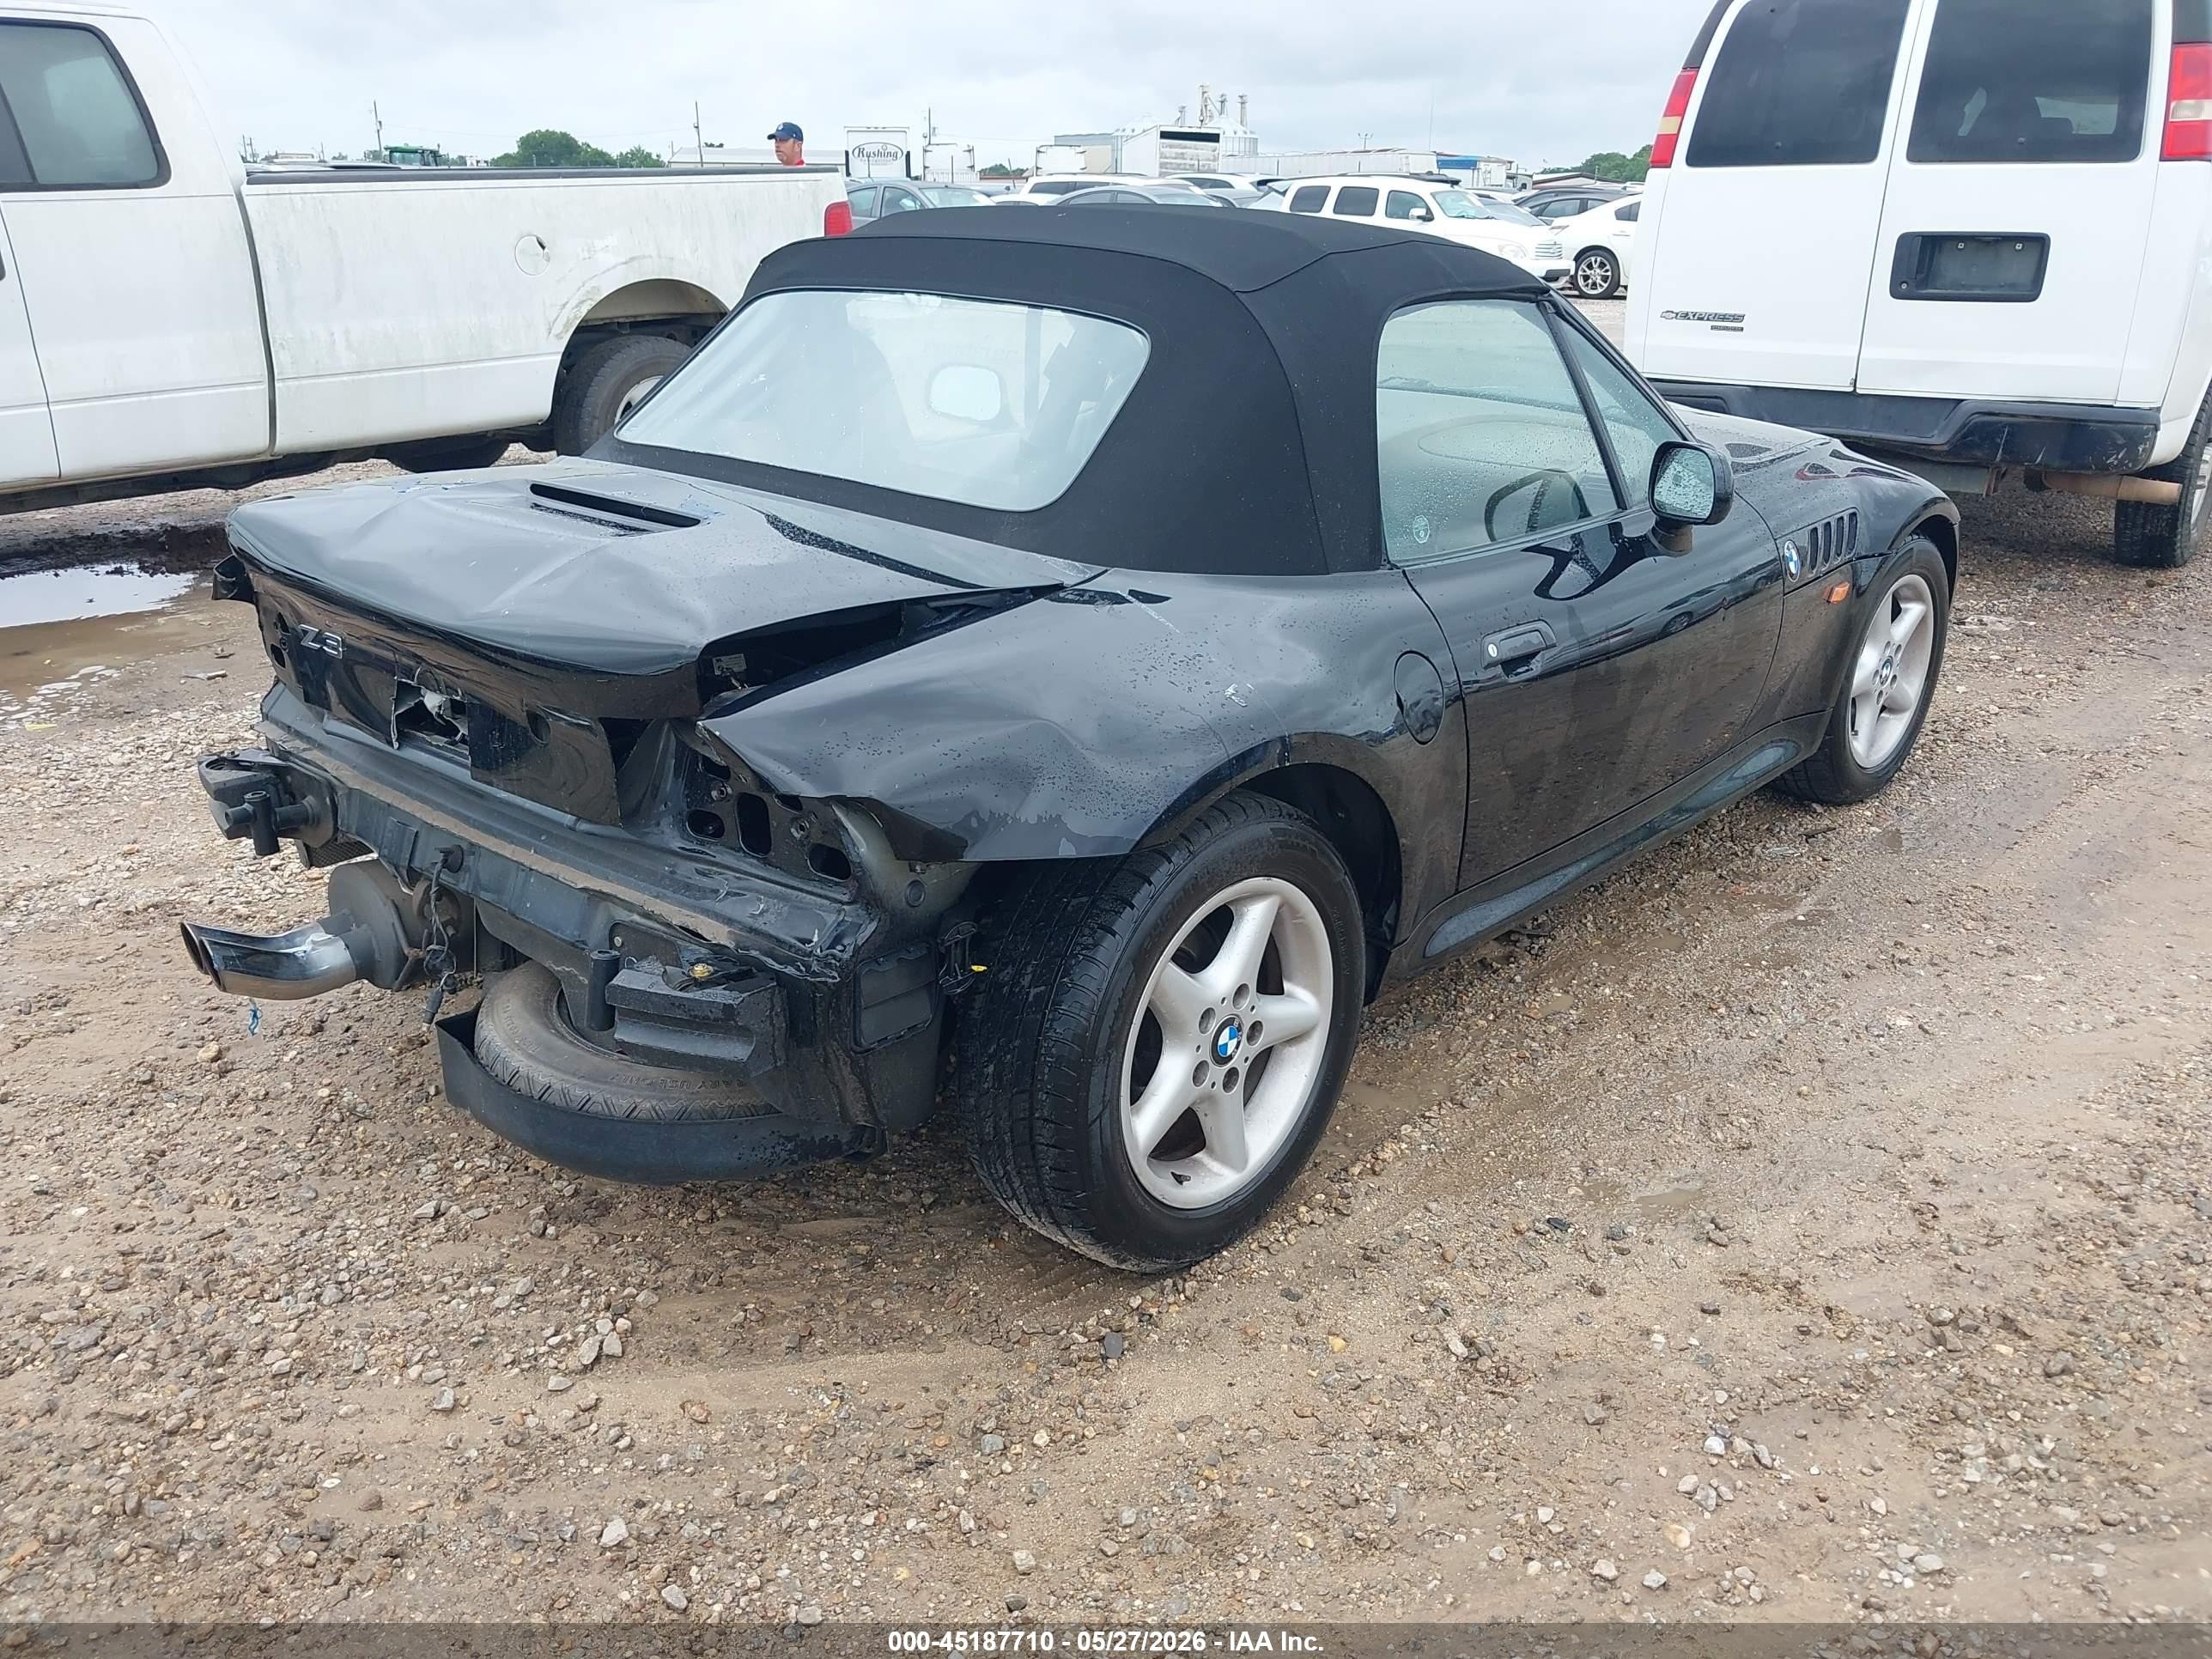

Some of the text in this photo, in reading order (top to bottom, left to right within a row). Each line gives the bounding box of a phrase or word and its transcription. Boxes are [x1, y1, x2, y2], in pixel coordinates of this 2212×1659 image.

[857, 144, 899, 161] Rushing
[1675, 311, 1745, 323] EXPRESS
[298, 623, 343, 659] Z3
